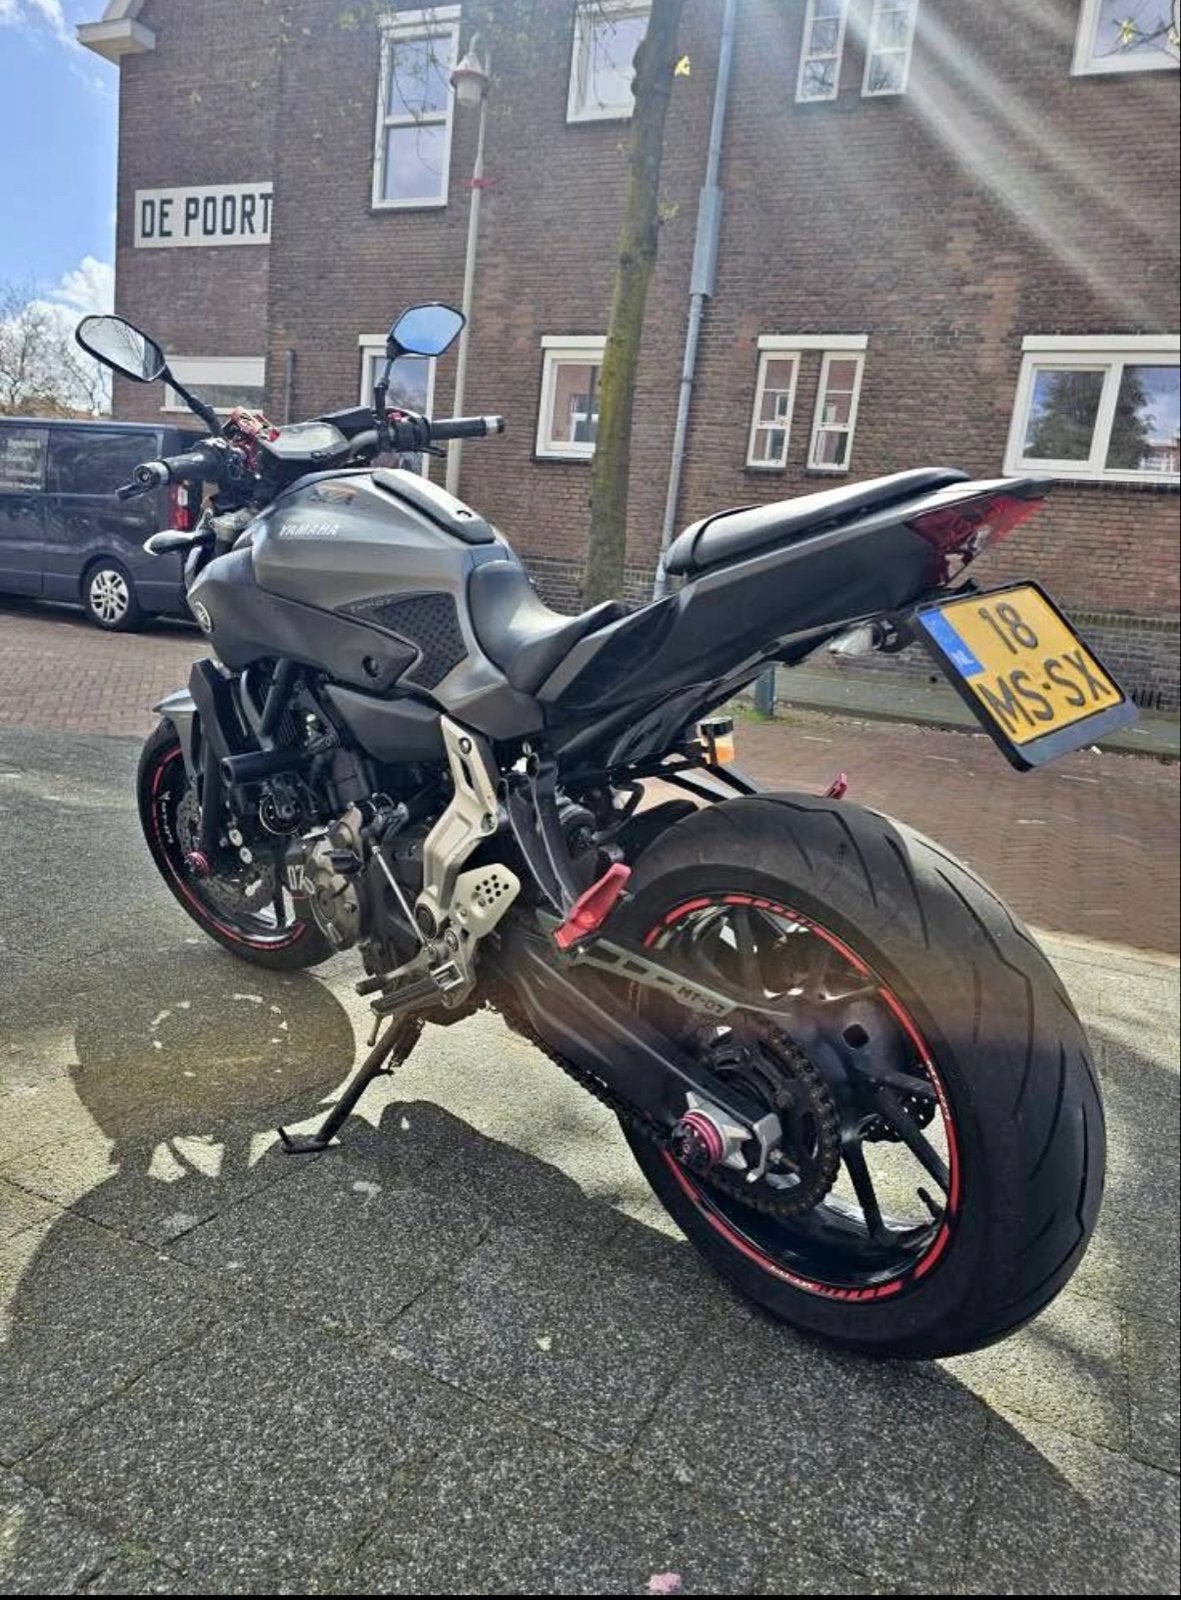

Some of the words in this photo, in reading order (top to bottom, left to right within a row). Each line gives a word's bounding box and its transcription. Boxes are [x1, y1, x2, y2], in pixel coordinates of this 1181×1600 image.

[141, 199, 173, 238] DE
[184, 192, 273, 237] POORT
[279, 523, 340, 537] YAMAHA
[978, 602, 1039, 655] 18
[677, 986, 725, 1014] MT-07
